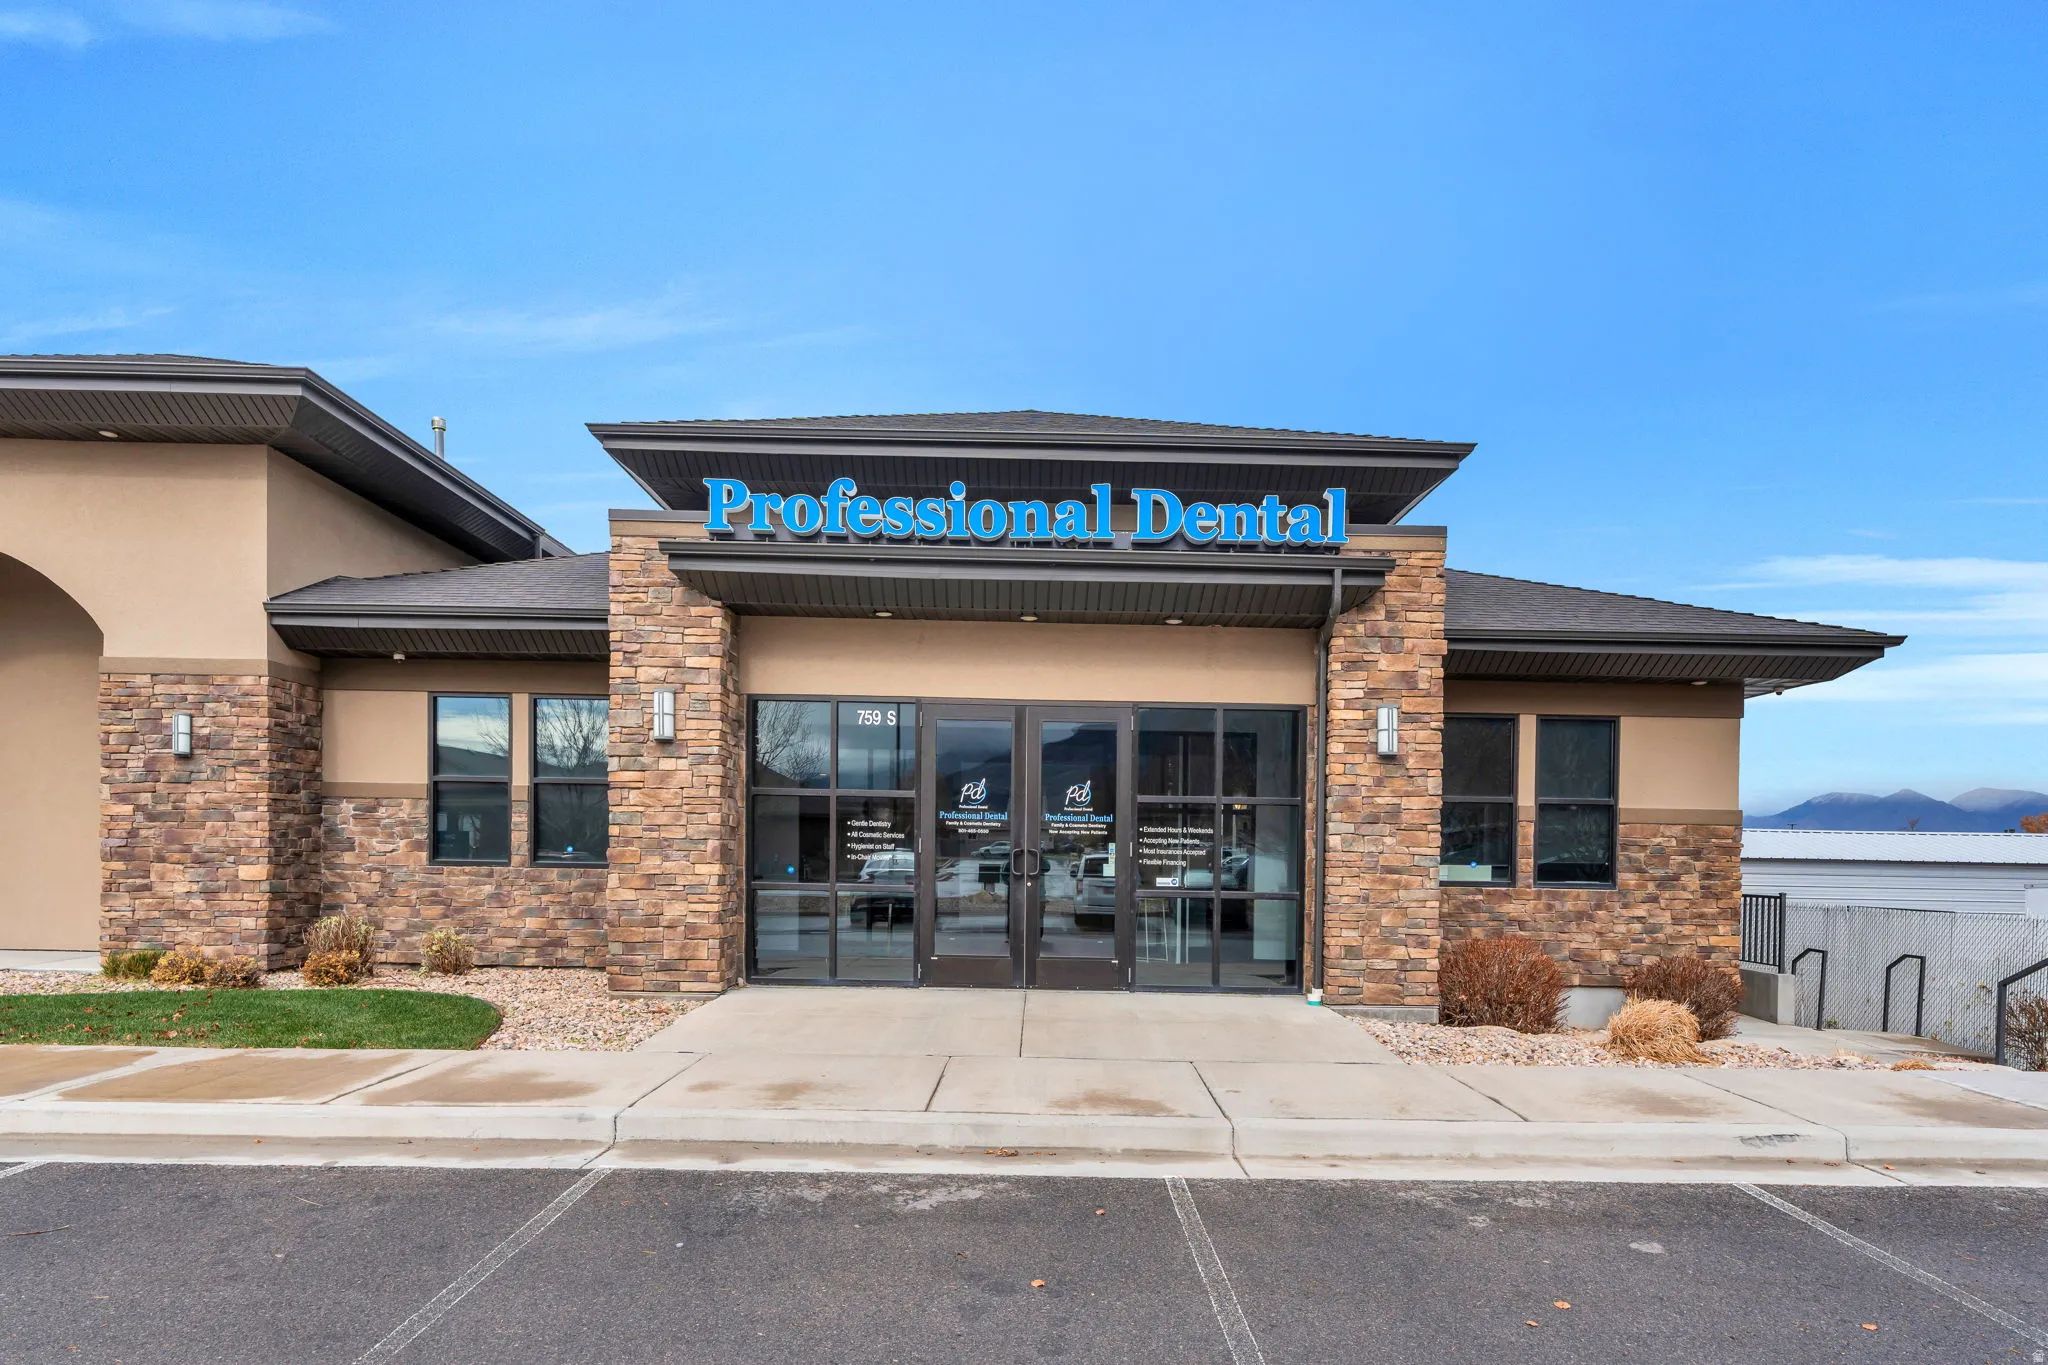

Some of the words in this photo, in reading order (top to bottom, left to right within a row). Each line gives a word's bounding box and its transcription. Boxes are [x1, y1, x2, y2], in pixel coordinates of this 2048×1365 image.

[703, 477, 1116, 543] Professional
[1131, 487, 1350, 546] Dental
[857, 710, 881, 725] 759
[887, 710, 896, 725] S
[939, 811, 983, 820] Professional
[984, 811, 1008, 820] Dental
[1045, 813, 1088, 822] Professional
[1090, 814, 1113, 823] Dental
[869, 820, 891, 829] Dentistry
[1143, 837, 1167, 845] Accepting
[1163, 859, 1187, 867] Financing
